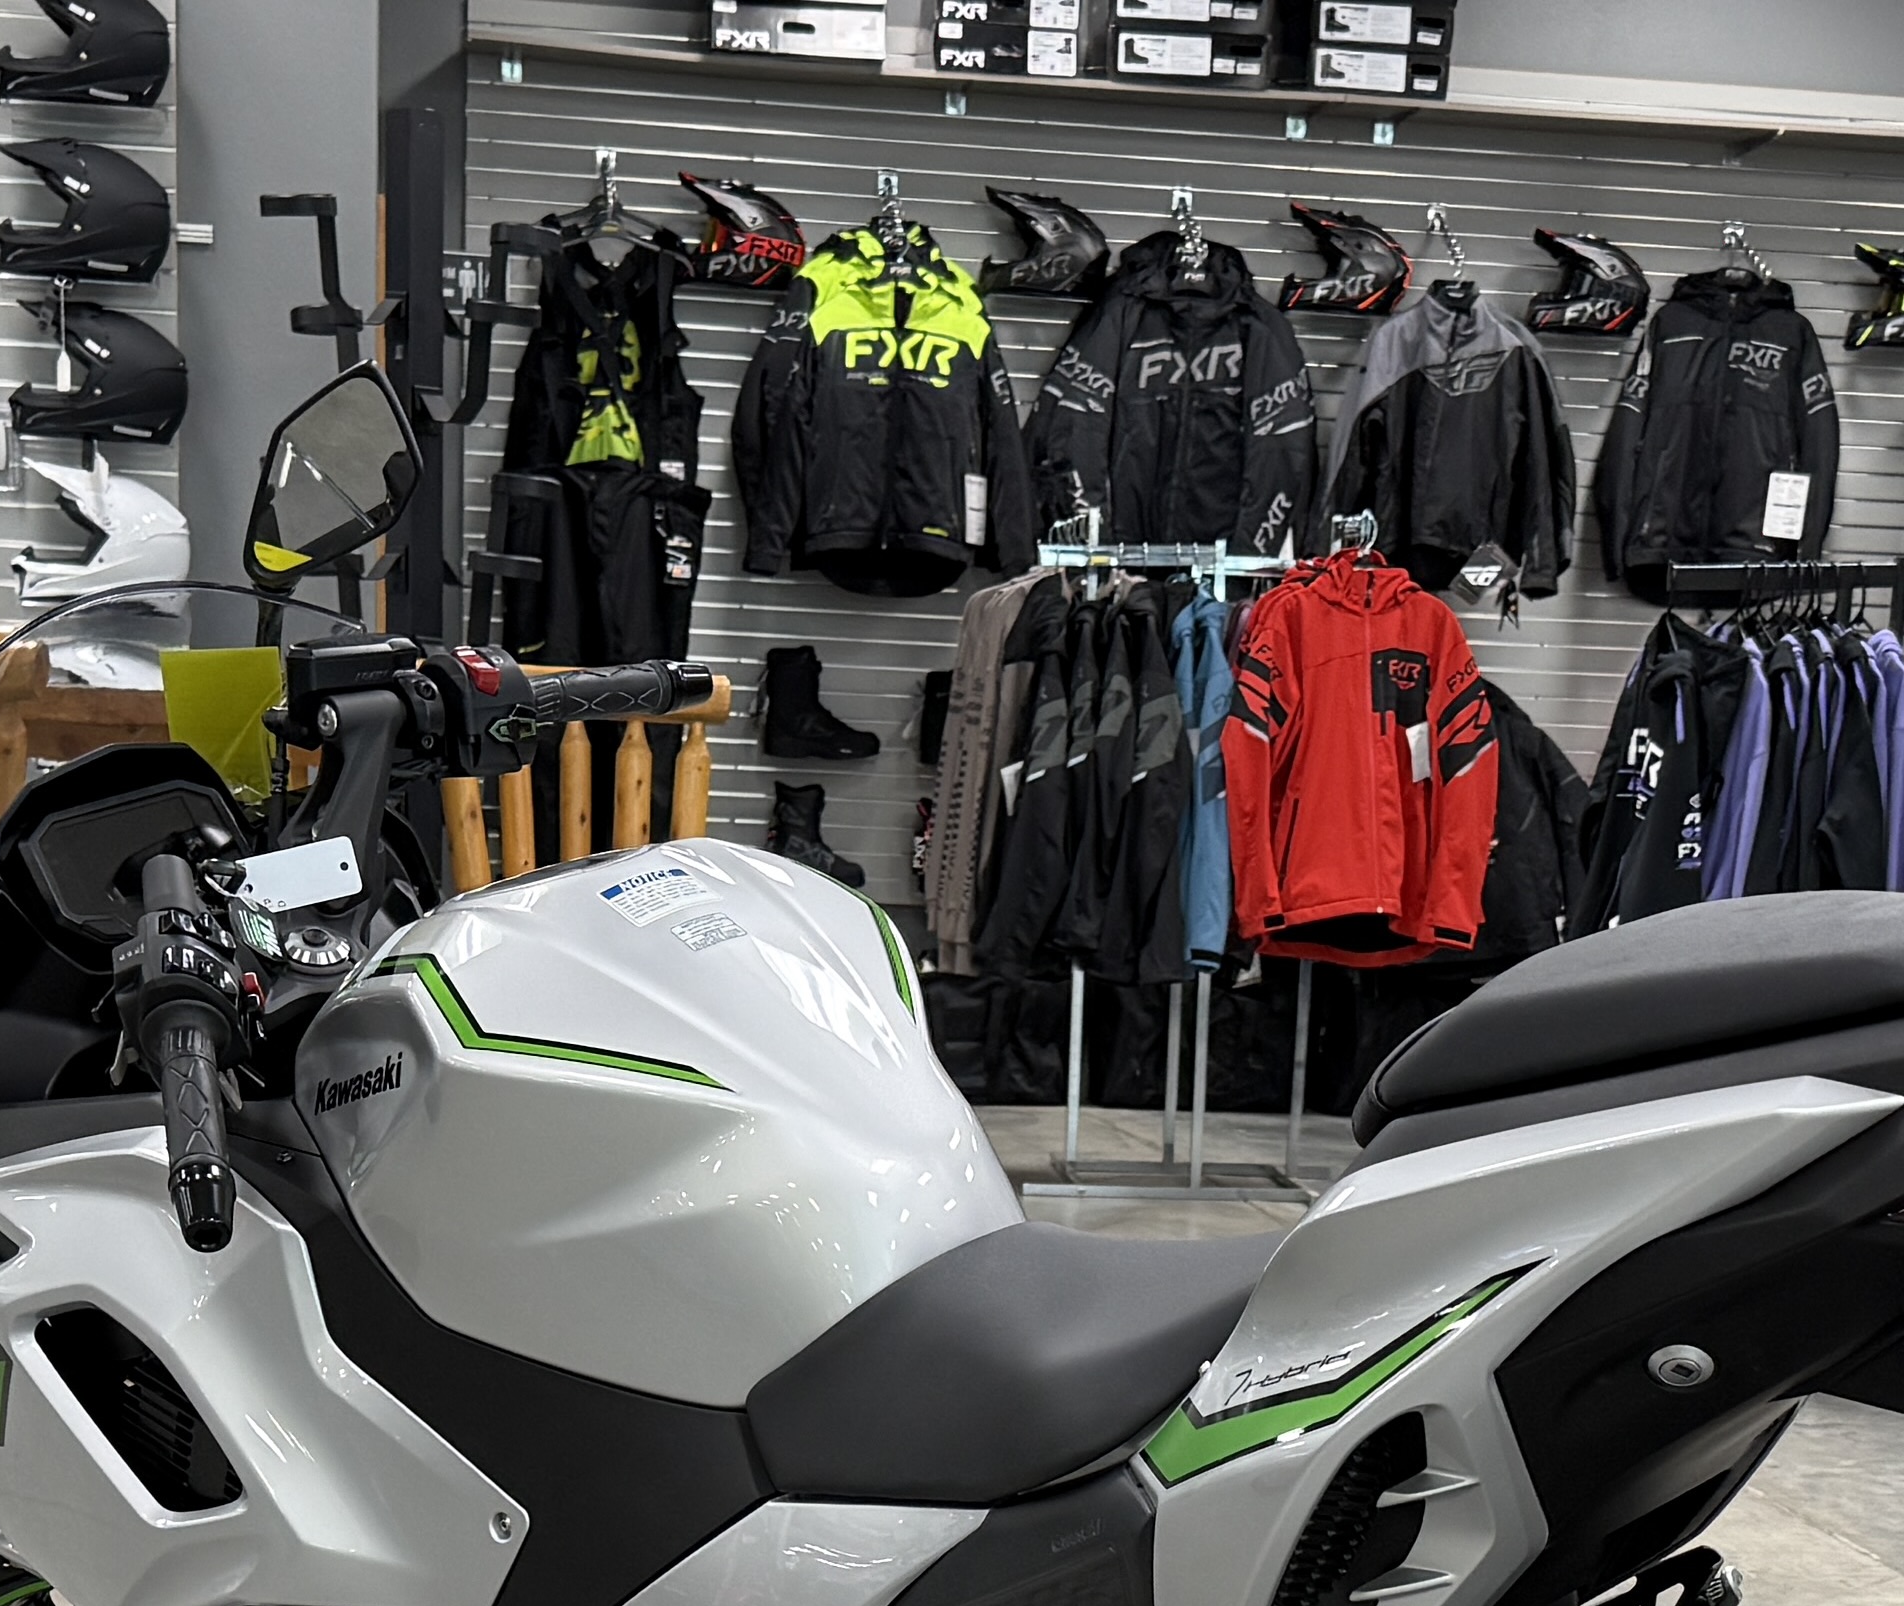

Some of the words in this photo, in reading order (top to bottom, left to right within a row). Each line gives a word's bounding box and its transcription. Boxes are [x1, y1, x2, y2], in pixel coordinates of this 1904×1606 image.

[943, 1, 988, 21] FXR
[715, 29, 771, 50] FXR
[940, 49, 986, 68] FXR
[749, 236, 799, 266] FXR
[1010, 255, 1071, 287] FXR
[1312, 273, 1376, 303] FXR
[1563, 298, 1622, 327] FXR
[845, 330, 961, 377] FXR
[1139, 343, 1243, 390] FXR
[1728, 341, 1784, 371] FXR
[1072, 362, 1116, 400] FXR
[1250, 378, 1300, 423] FXR
[1251, 491, 1295, 555] FXR
[314, 1051, 404, 1117] Kawasaki
